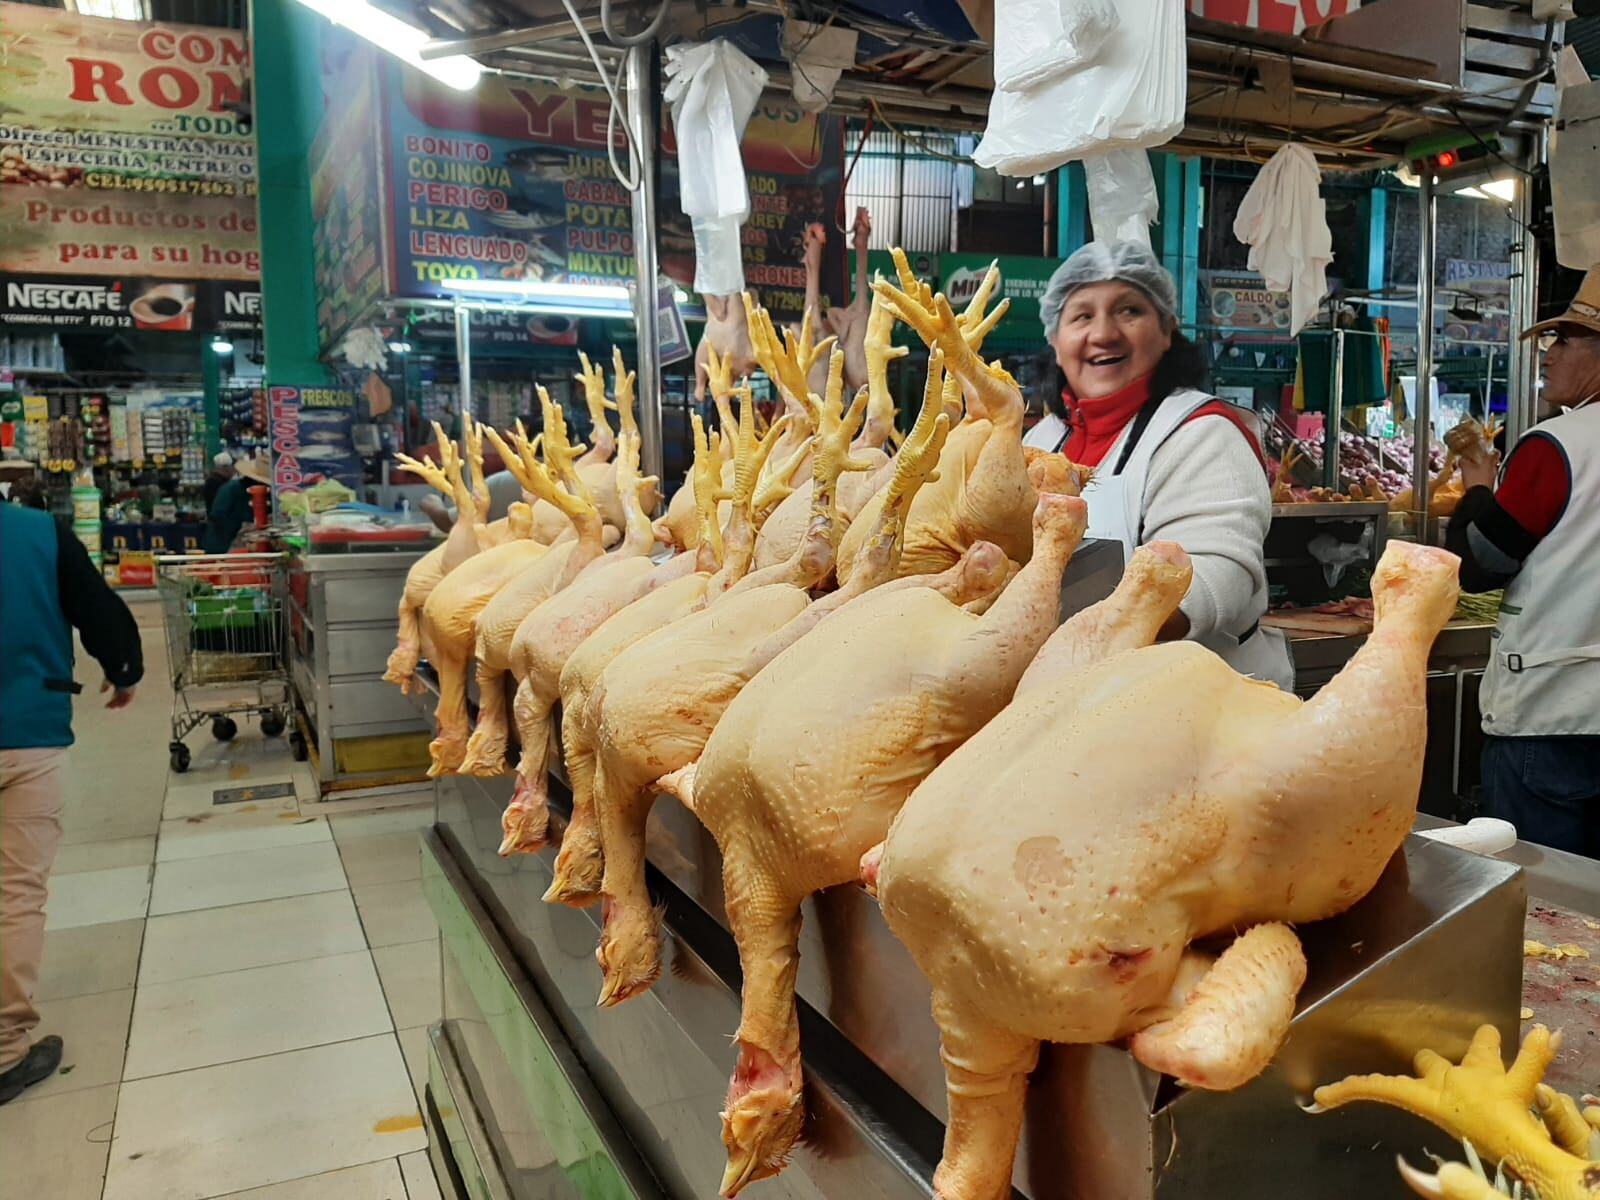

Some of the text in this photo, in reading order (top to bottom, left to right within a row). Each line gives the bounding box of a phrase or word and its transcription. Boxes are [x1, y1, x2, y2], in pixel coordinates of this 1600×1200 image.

[406, 135, 491, 162] BONITO
[408, 157, 512, 188] COJINOVA
[408, 180, 508, 211] PERICO
[27, 200, 258, 232] Productos de
[410, 207, 470, 230] LIZA
[566, 203, 630, 227] POTA
[59, 243, 139, 263] para
[152, 244, 189, 262] su
[410, 230, 528, 264] LENGUADO
[412, 260, 478, 282] TOYO
[1447, 258, 1511, 280] RESTAU
[1235, 291, 1273, 304] CALDO
[90, 315, 115, 327] PTO
[118, 316, 132, 328] 12
[300, 388, 354, 407] FRESCOS
